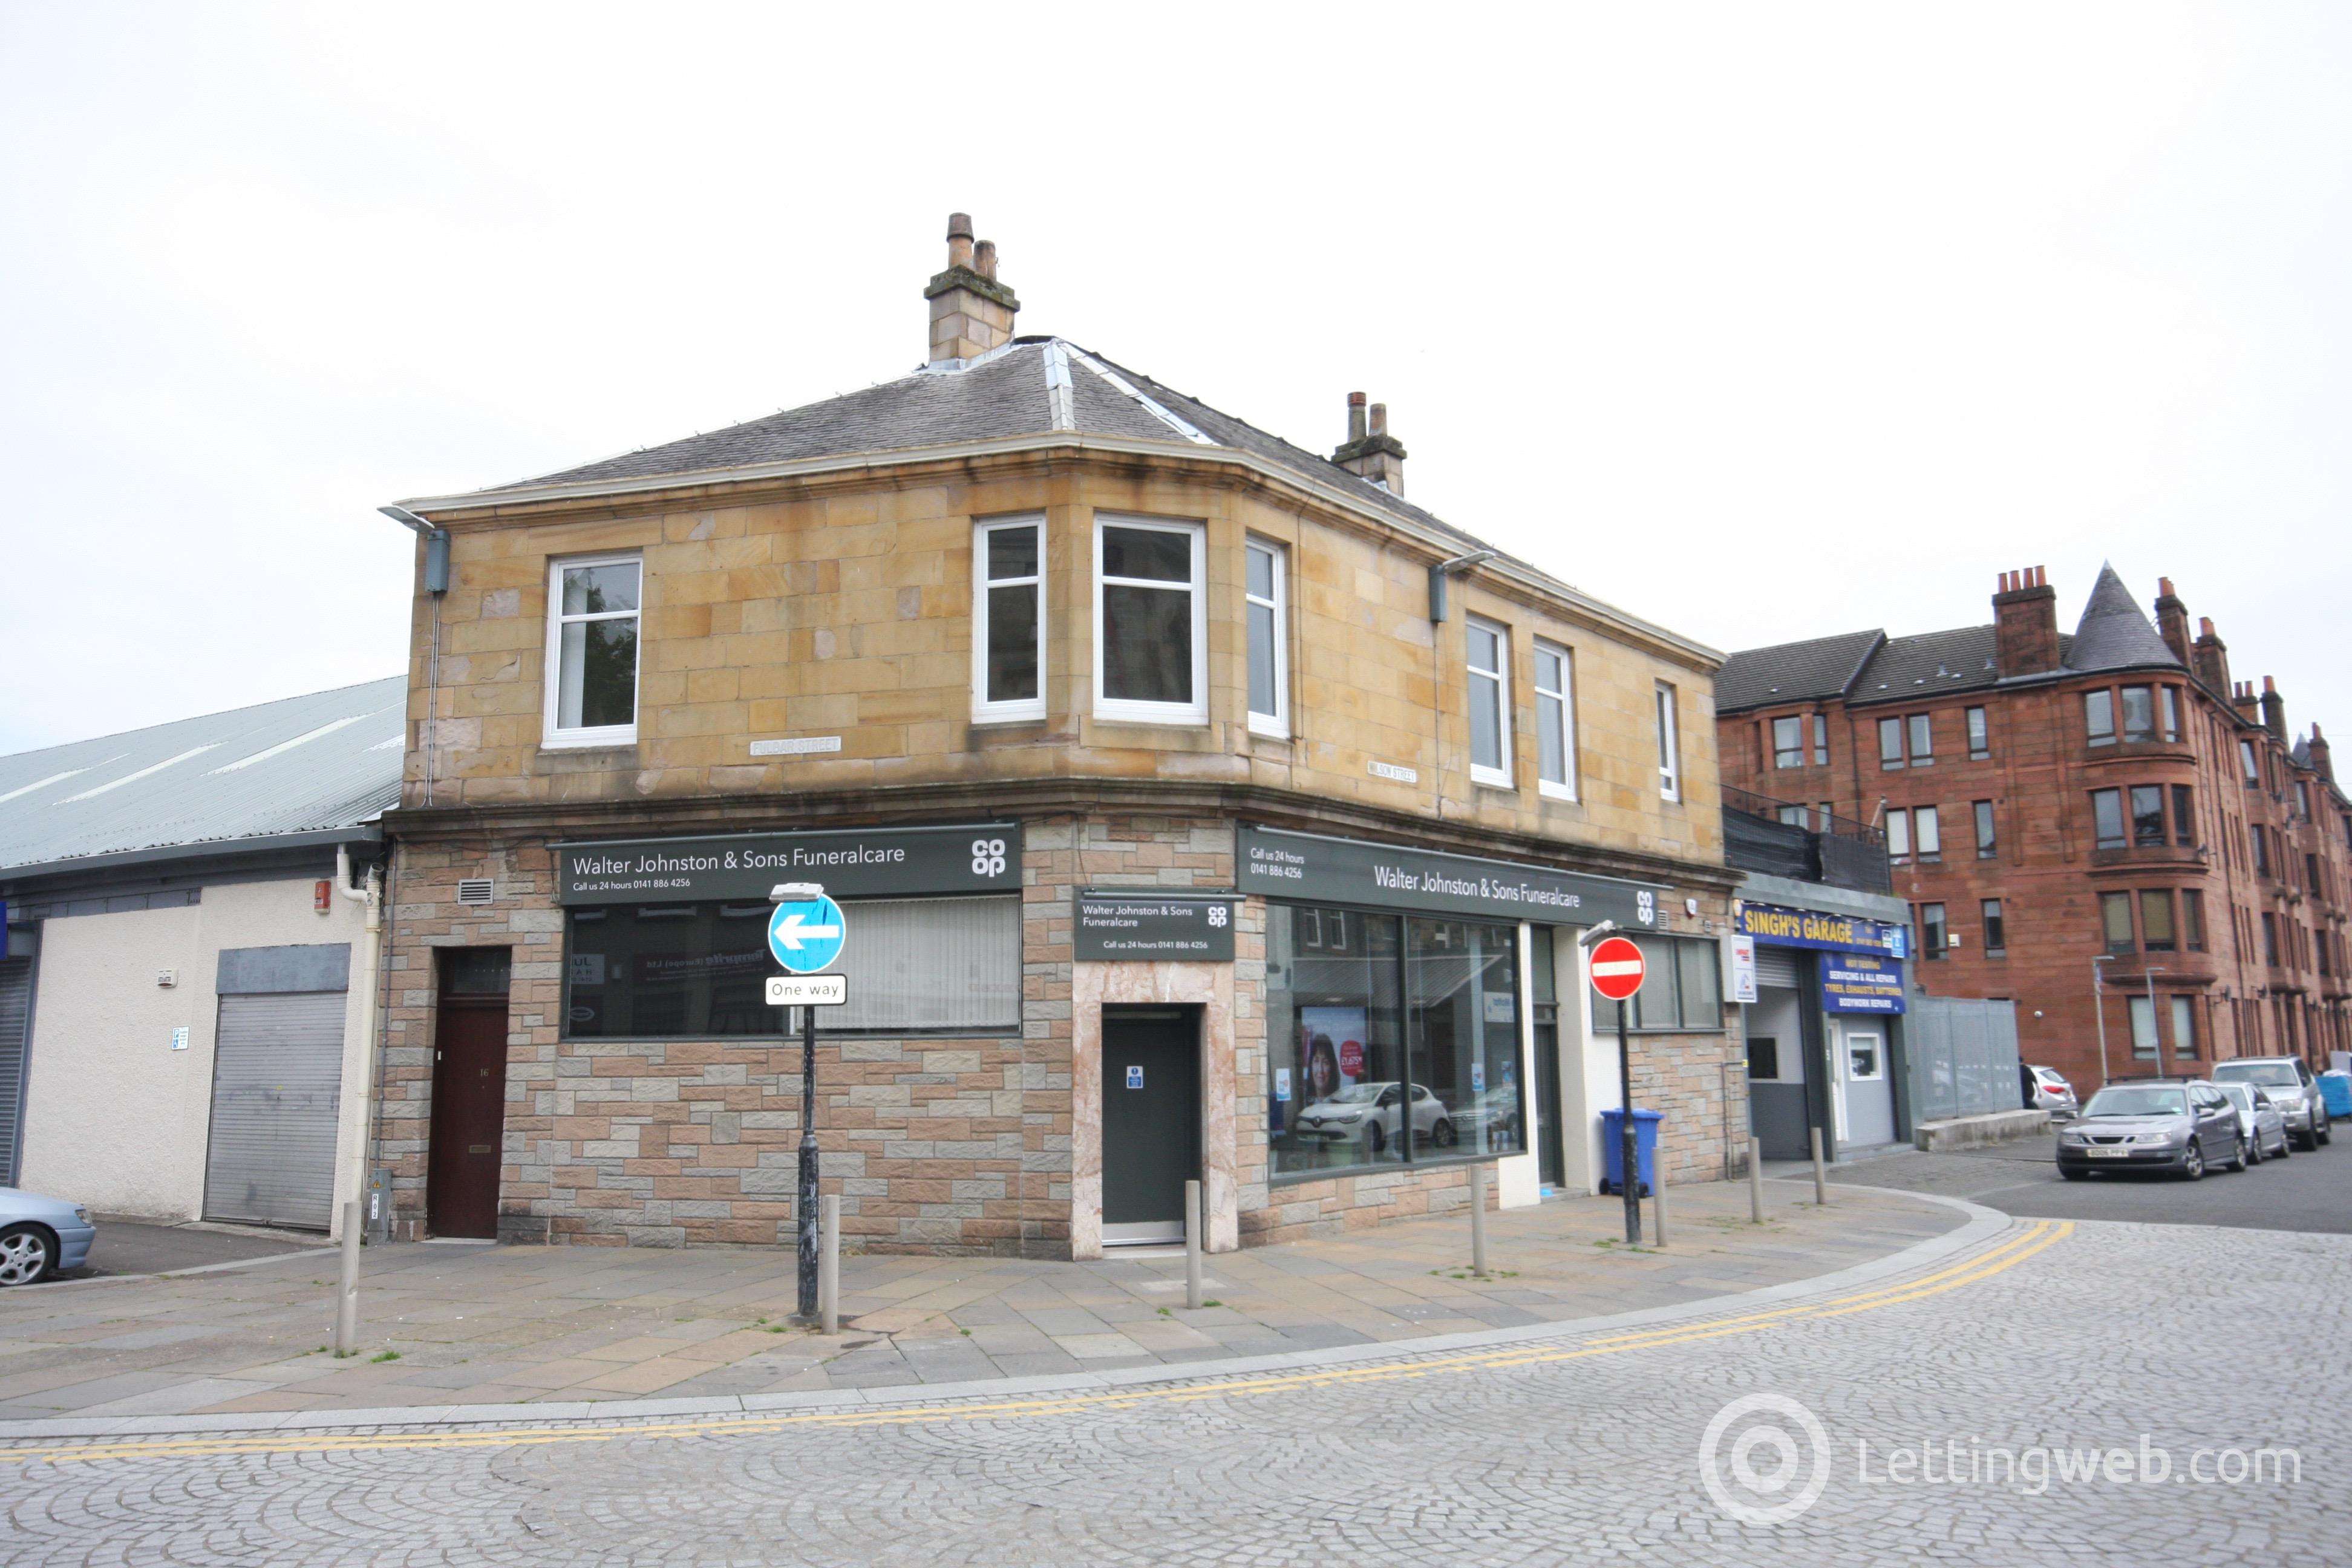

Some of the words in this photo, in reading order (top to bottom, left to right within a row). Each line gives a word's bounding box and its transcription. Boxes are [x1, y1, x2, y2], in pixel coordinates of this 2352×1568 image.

[753, 740, 794, 754] FULBAR
[798, 737, 838, 752] STREET
[1393, 766, 1415, 781] STREET
[573, 856, 631, 875] Walter
[635, 854, 718, 873] Johnston
[724, 851, 738, 869] &
[743, 850, 787, 868] Sons
[794, 844, 905, 866] Funeralcare
[1250, 848, 1264, 859] Call
[1275, 851, 1284, 861] 24
[1285, 851, 1304, 864] hours
[1250, 863, 1267, 875] 0141
[1269, 864, 1283, 877] 886
[1284, 867, 1302, 878] 4256
[573, 882, 587, 891] Call
[599, 881, 609, 890] 24
[611, 881, 632, 889] hours
[633, 880, 652, 889] 0141
[653, 879, 669, 888] 886
[670, 878, 691, 887] 4256
[1374, 865, 1419, 890] Walter
[1421, 872, 1478, 897] Johnston
[1480, 878, 1490, 898] &
[1492, 880, 1519, 901] Sons
[1520, 883, 1580, 907] Funeralcare
[1082, 905, 1114, 915] Walter
[1116, 906, 1158, 915] Johnston
[1161, 907, 1168, 916] &
[1170, 906, 1192, 916] Sons
[1082, 917, 1138, 927] Funeralcare
[1745, 909, 1801, 938] SINGH'S
[1803, 918, 1853, 944] GARAGE
[1865, 973, 1875, 982] ALL
[772, 983, 802, 996] One
[809, 985, 838, 997] way
